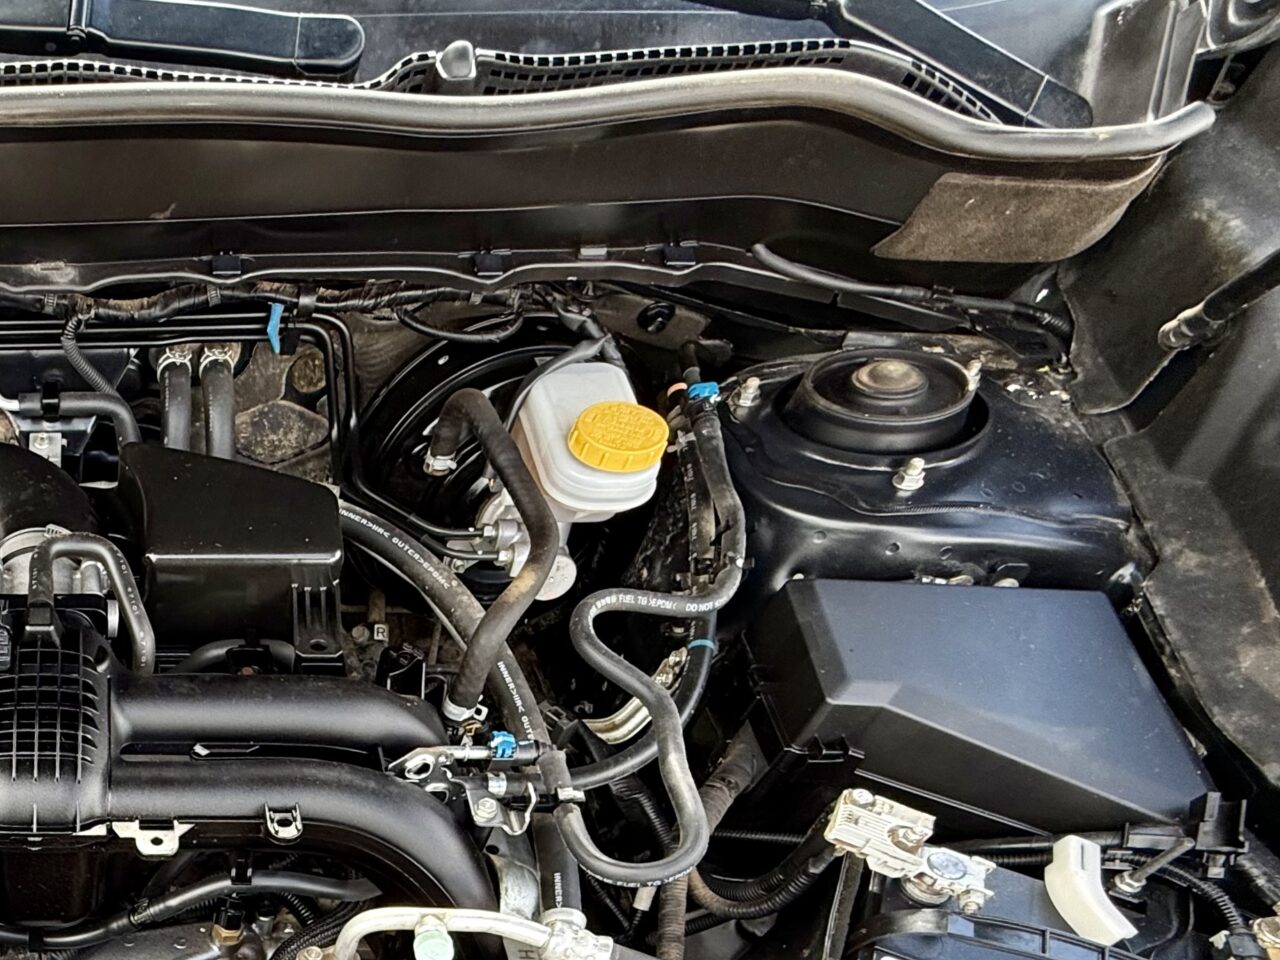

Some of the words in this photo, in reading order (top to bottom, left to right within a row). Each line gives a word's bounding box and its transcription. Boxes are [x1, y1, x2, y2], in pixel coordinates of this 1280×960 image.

[391, 536, 451, 590] OUTER>EPDM<
[376, 626, 386, 639] R
[521, 715, 535, 743] OUTE
